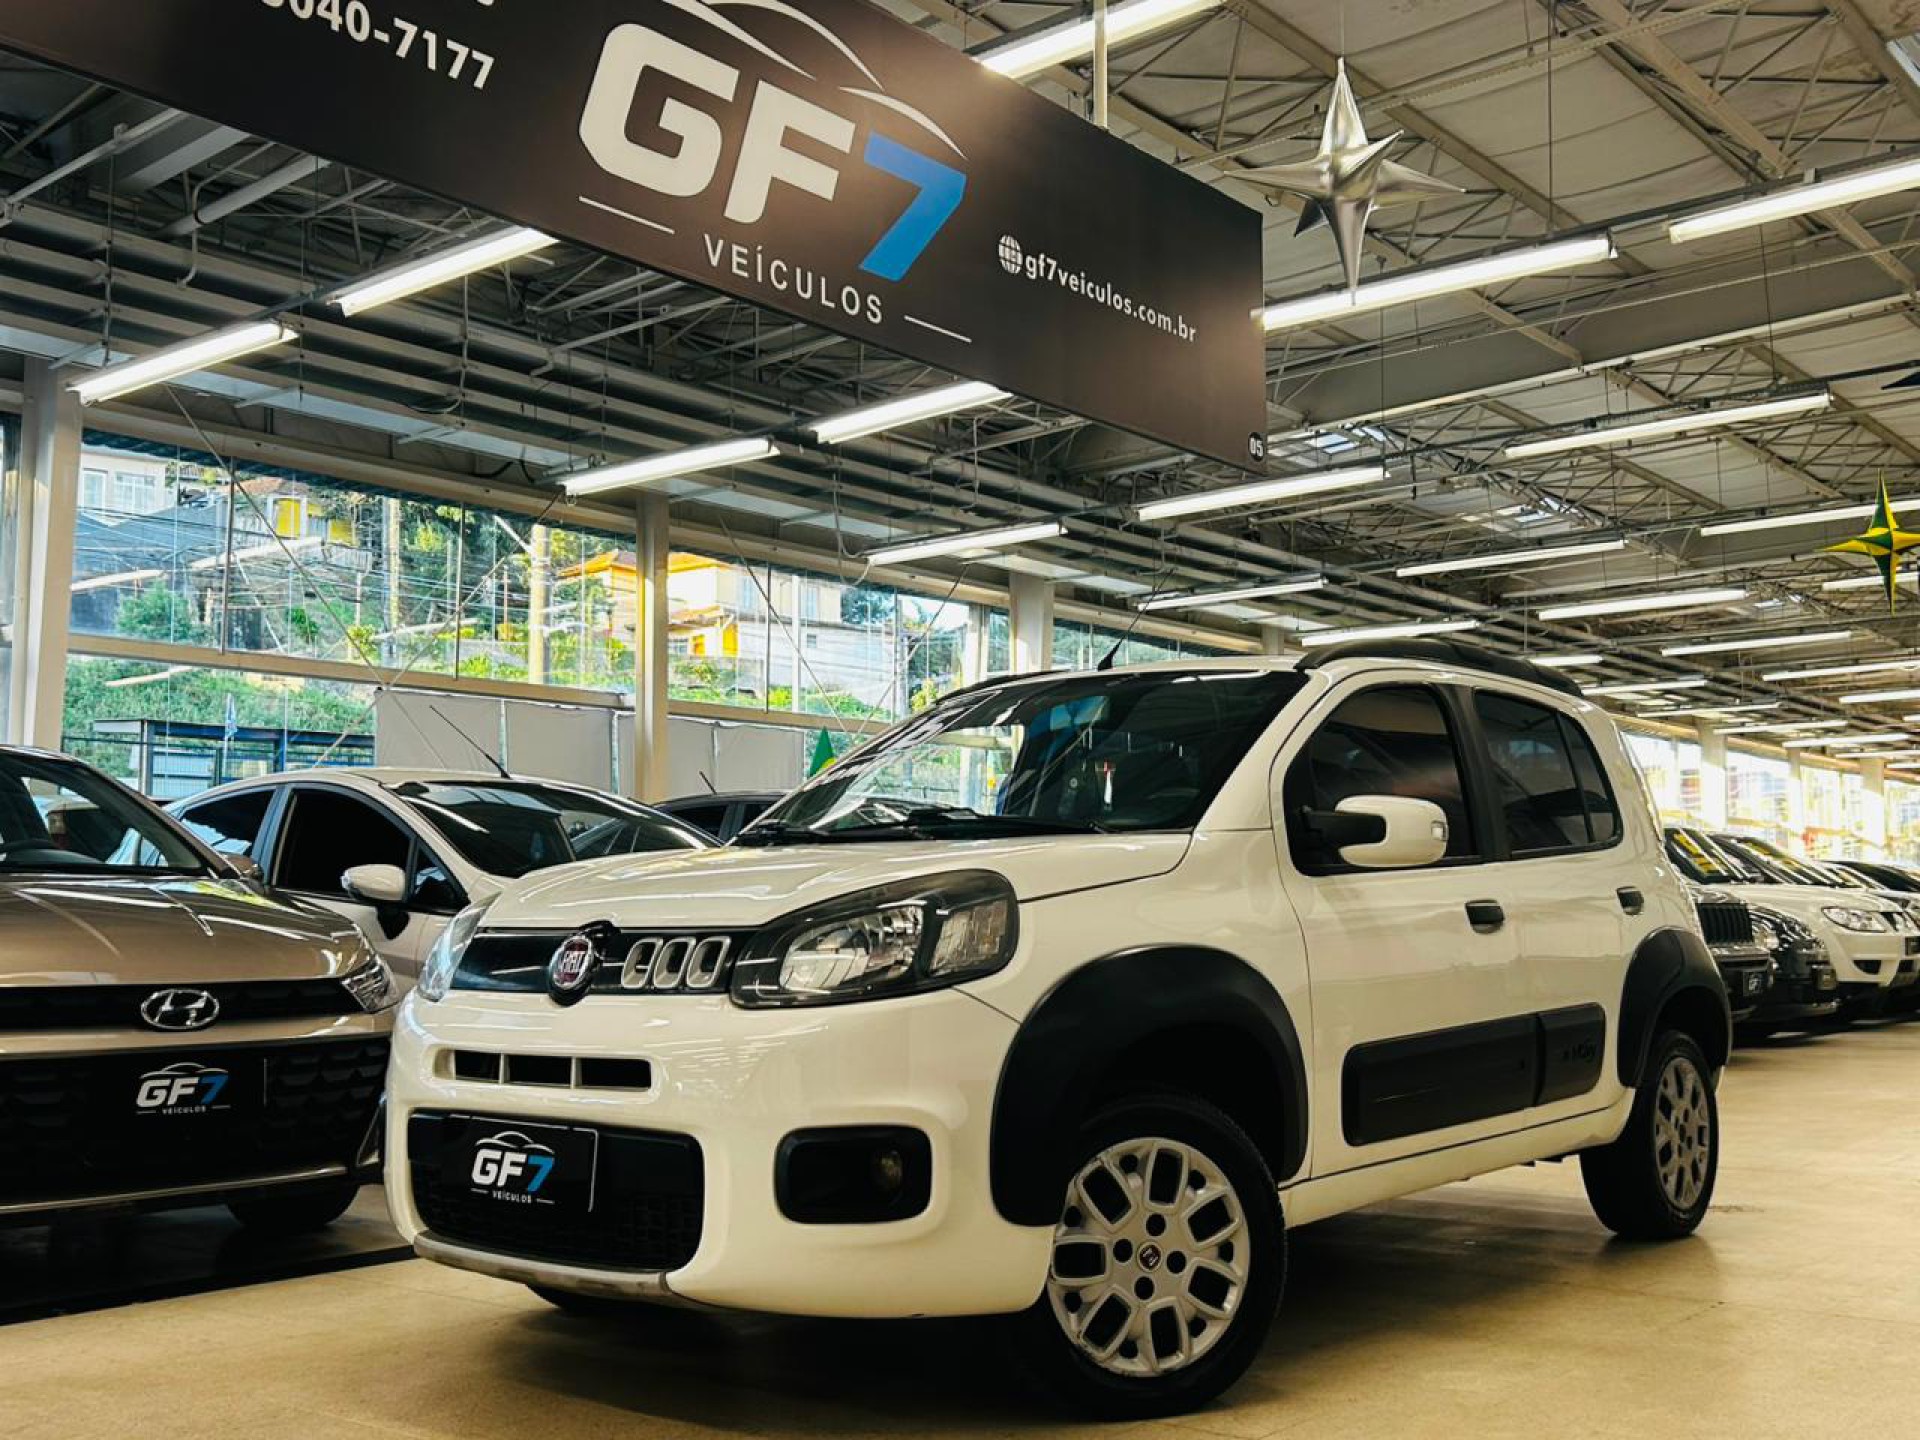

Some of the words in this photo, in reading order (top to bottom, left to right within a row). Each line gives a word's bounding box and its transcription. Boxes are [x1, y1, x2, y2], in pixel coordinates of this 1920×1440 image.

[261, 0, 496, 90] 40-7177
[578, 22, 968, 283] GF7
[703, 233, 883, 325] VEÍCULOS
[1025, 252, 1197, 342] gf7veiculos.com.br
[1249, 437, 1264, 458] 05
[136, 1073, 229, 1108] GF7
[471, 1148, 555, 1193] GF7
